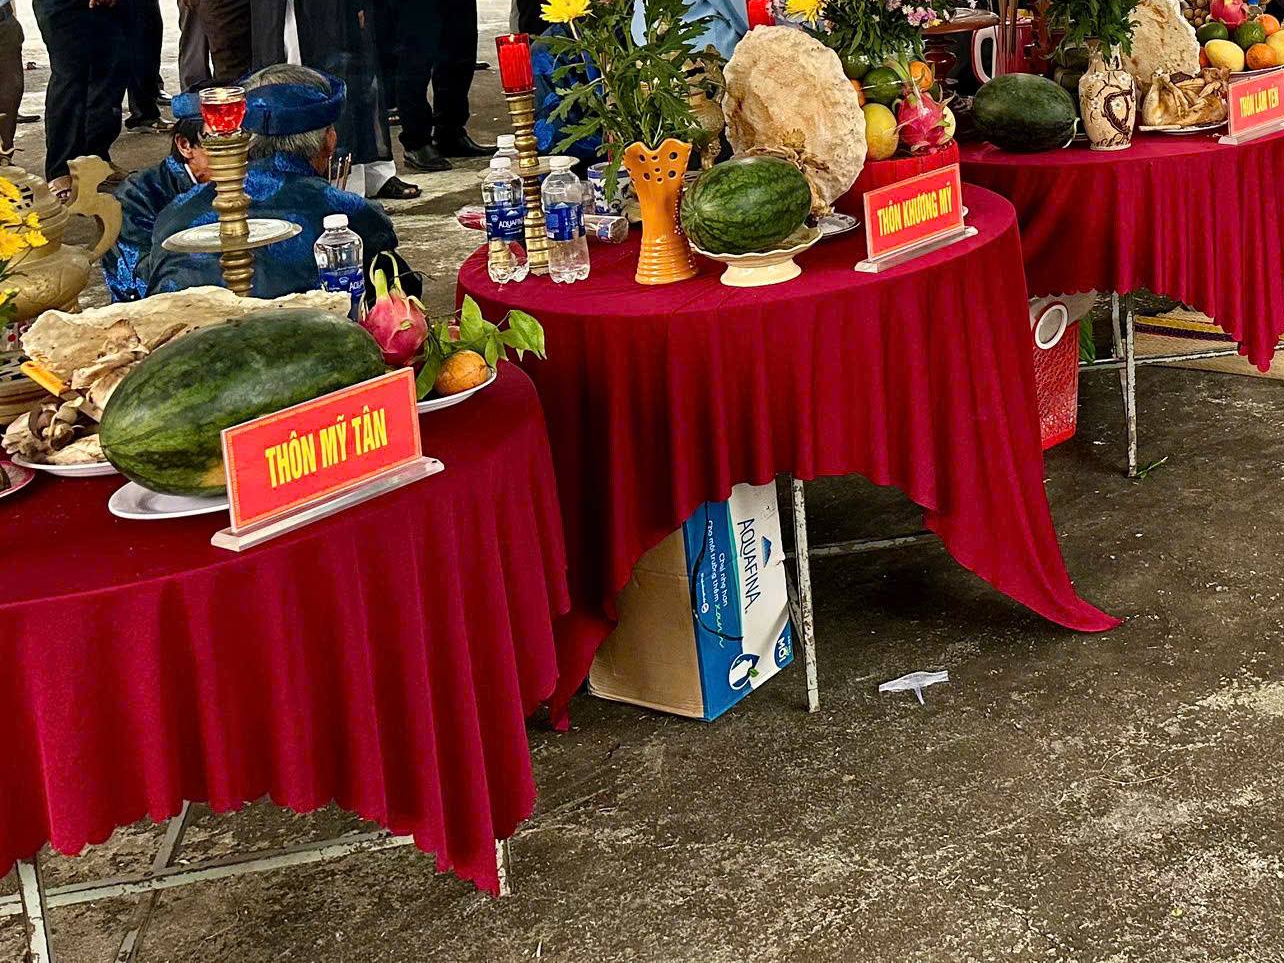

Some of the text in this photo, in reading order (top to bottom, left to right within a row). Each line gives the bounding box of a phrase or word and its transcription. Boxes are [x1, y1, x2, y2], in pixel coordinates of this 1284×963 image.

[877, 200, 902, 237] THÔN
[265, 405, 388, 488] THÔN MỸ TÂN
[737, 518, 761, 612] AQUAFINA
